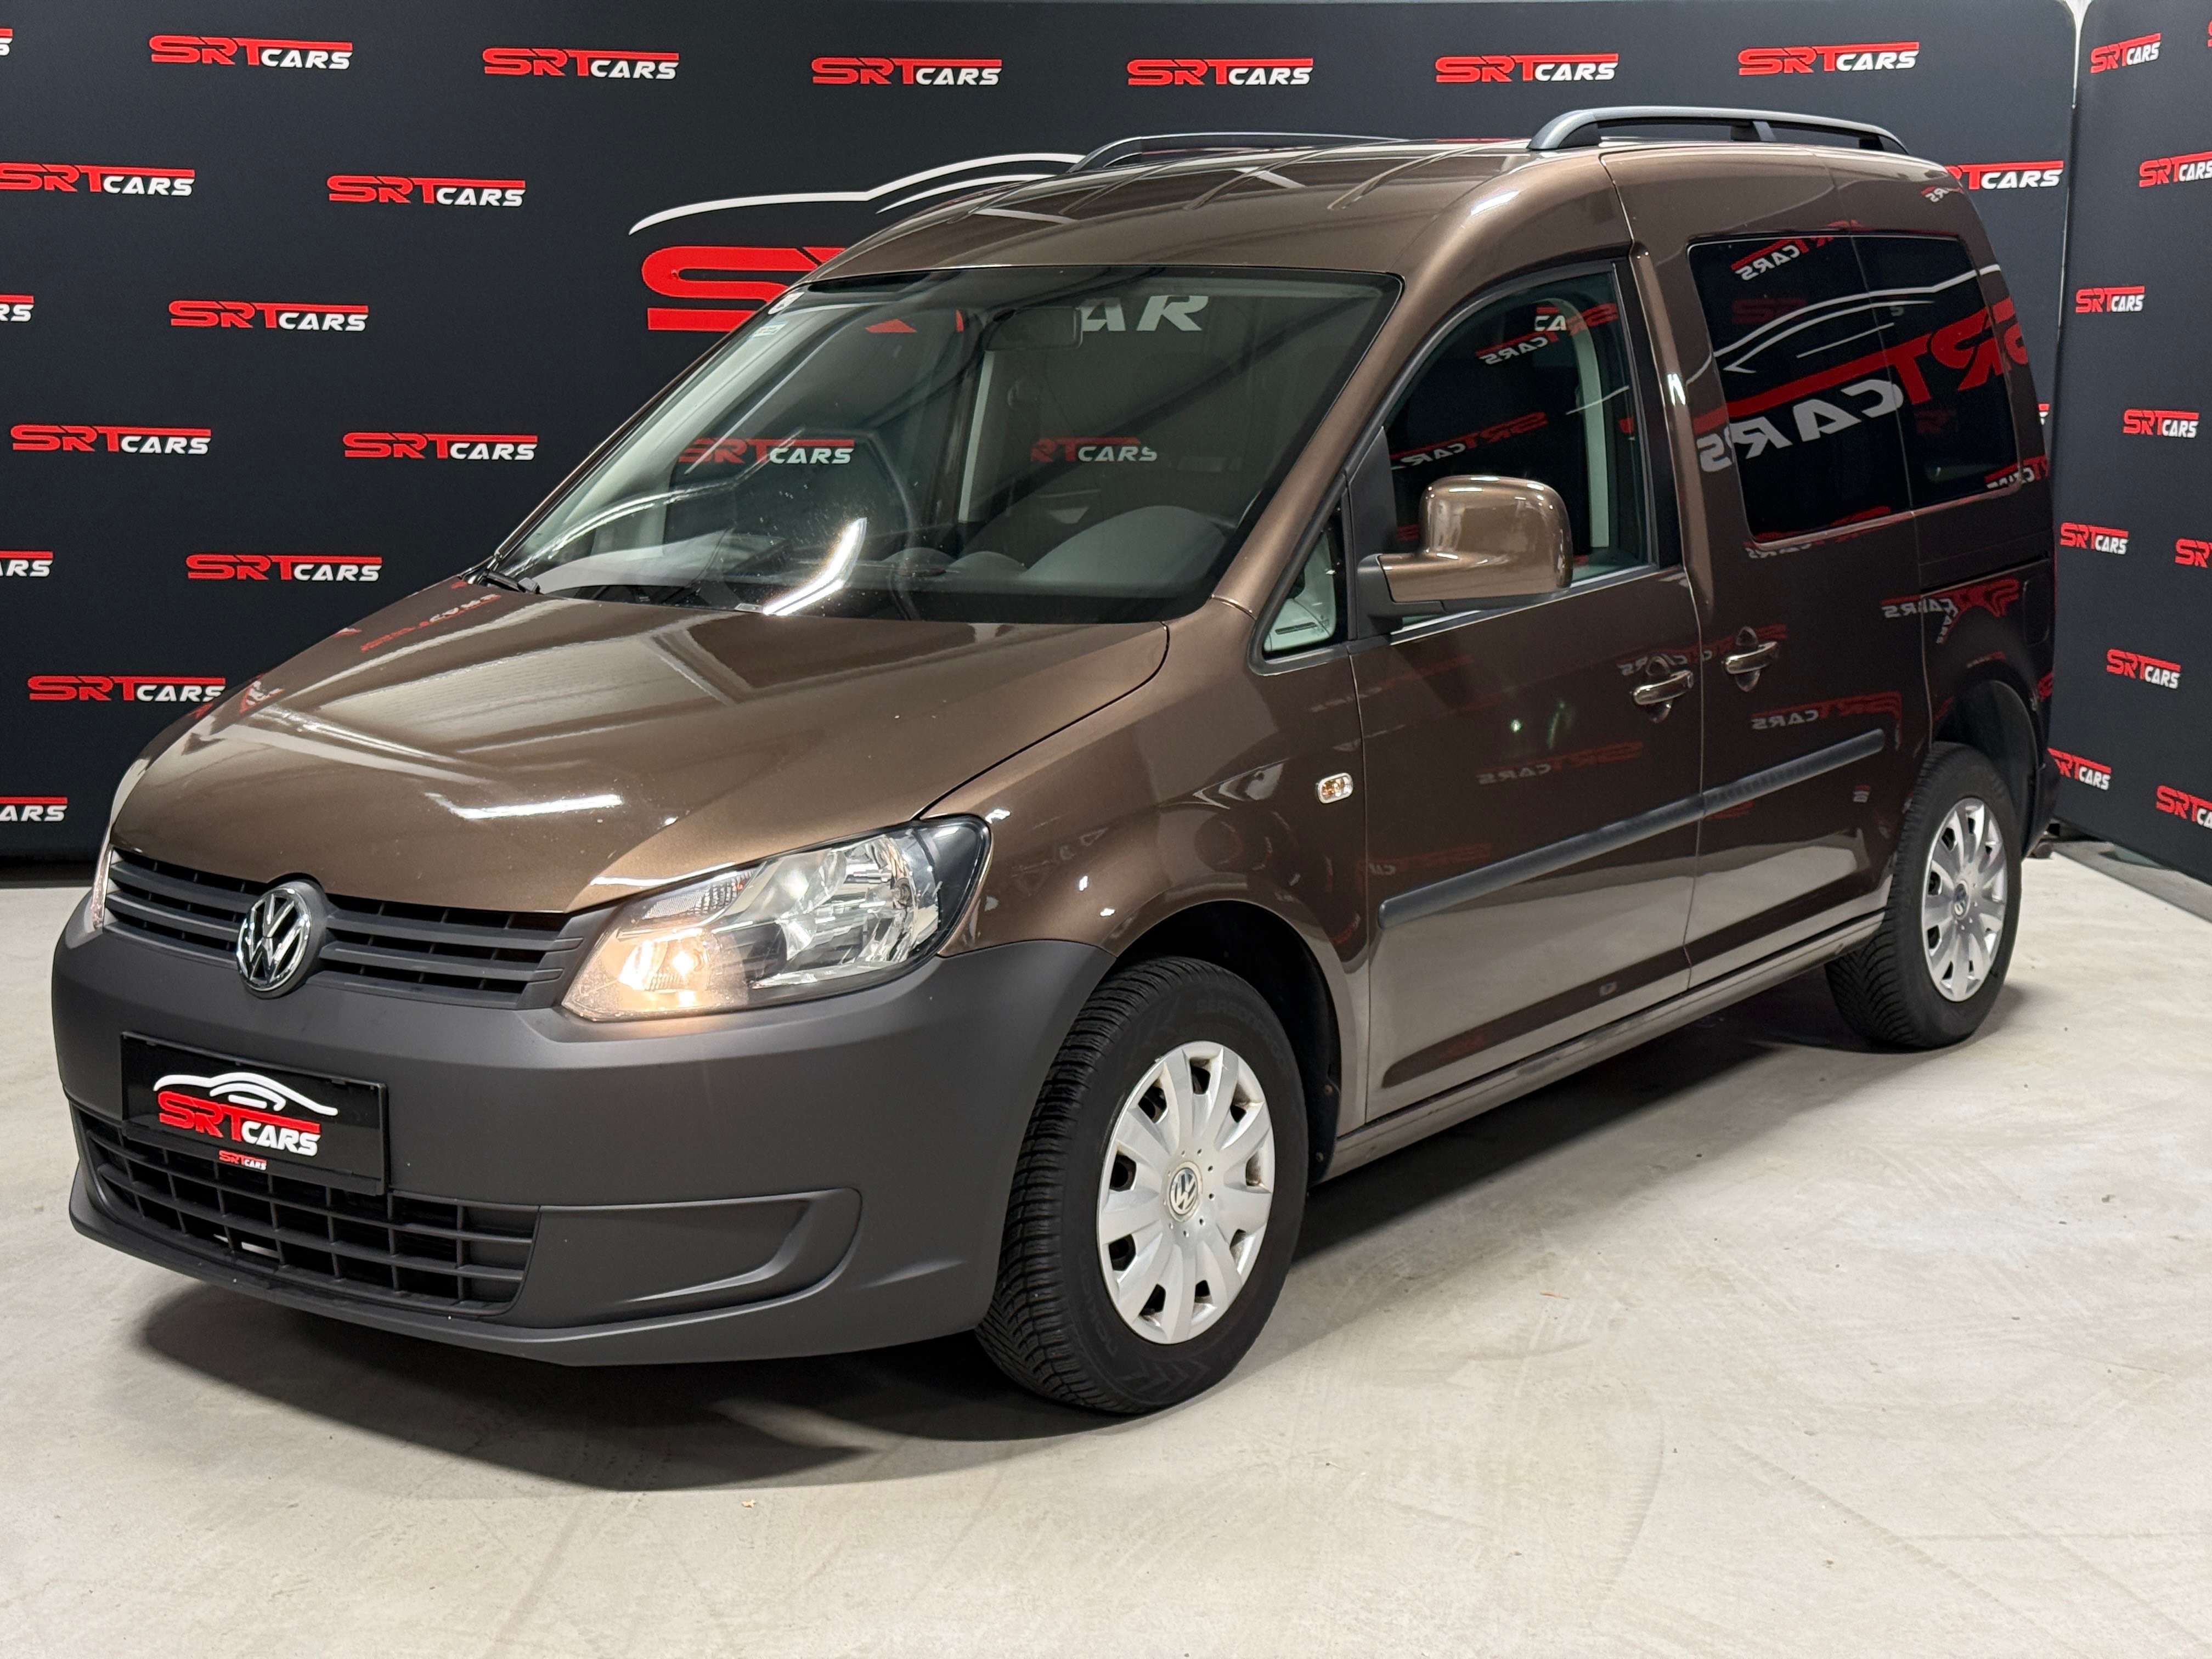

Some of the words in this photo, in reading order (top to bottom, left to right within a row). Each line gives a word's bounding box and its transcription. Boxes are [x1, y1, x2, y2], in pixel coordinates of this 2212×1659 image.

[149, 35, 353, 65] SRT
[261, 49, 352, 69] CARS
[482, 47, 679, 77] SRT
[591, 60, 679, 80] CARS
[1738, 42, 1919, 76] SRT
[1836, 50, 1919, 71] CARS
[2090, 33, 2162, 73] SRT
[2126, 42, 2160, 65] CARS
[811, 57, 1002, 84] SRT
[916, 68, 1001, 85] CARS
[1127, 57, 1313, 86] SRT
[1229, 67, 1313, 85] CARS
[1435, 53, 1619, 83] SRT
[1534, 62, 1618, 81] CARS
[0, 162, 195, 193] SRT
[104, 176, 194, 196] CARS
[1982, 170, 2063, 189] CARS
[2139, 151, 2212, 187] SRT
[327, 175, 526, 204] SRT
[437, 188, 525, 206] CARS
[2075, 286, 2145, 313] SRT
[2111, 295, 2145, 312] CARS
[168, 300, 369, 329] SRT
[279, 313, 368, 331] CARS
[2123, 409, 2199, 435] SRT
[2162, 420, 2198, 438] CARS
[10, 424, 211, 452] SRT
[121, 436, 211, 454] CARS
[342, 432, 538, 459] SRT
[450, 443, 537, 460] CARS
[1077, 446, 1158, 462] CARS
[769, 447, 854, 465] CARS
[2060, 522, 2128, 551] SRT
[2095, 535, 2128, 555] CARS
[2175, 538, 2212, 568] SR
[0, 560, 52, 577] RS
[185, 554, 382, 580] SRT
[294, 564, 381, 582] CARS
[2107, 649, 2181, 679] SRT
[2145, 666, 2180, 689] CARS
[27, 675, 225, 701] SRT
[2079, 767, 2111, 791] CARS
[0, 805, 67, 821] ARS
[2156, 786, 2212, 822] SRT
[2197, 808, 2212, 829] CA
[157, 1090, 321, 1142] SRT
[241, 1120, 321, 1156] CARS
[244, 1159, 267, 1171] CARS
